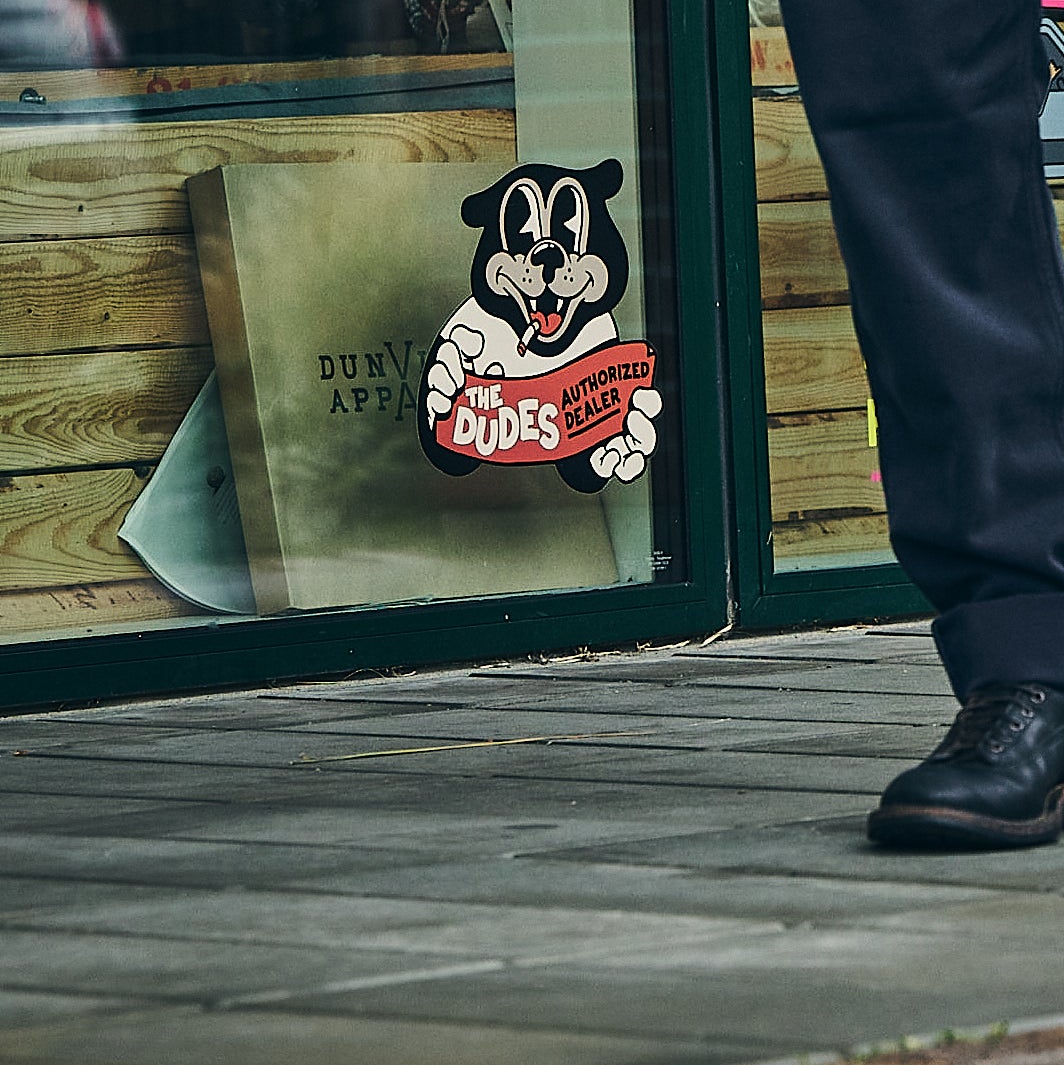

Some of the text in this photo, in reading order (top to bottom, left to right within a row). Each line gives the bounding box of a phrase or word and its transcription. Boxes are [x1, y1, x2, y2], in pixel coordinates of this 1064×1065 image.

[464, 383, 504, 411] THE
[561, 361, 650, 411] AUTHORIZED
[564, 387, 621, 430] DEALER
[453, 398, 560, 456] DUDES
